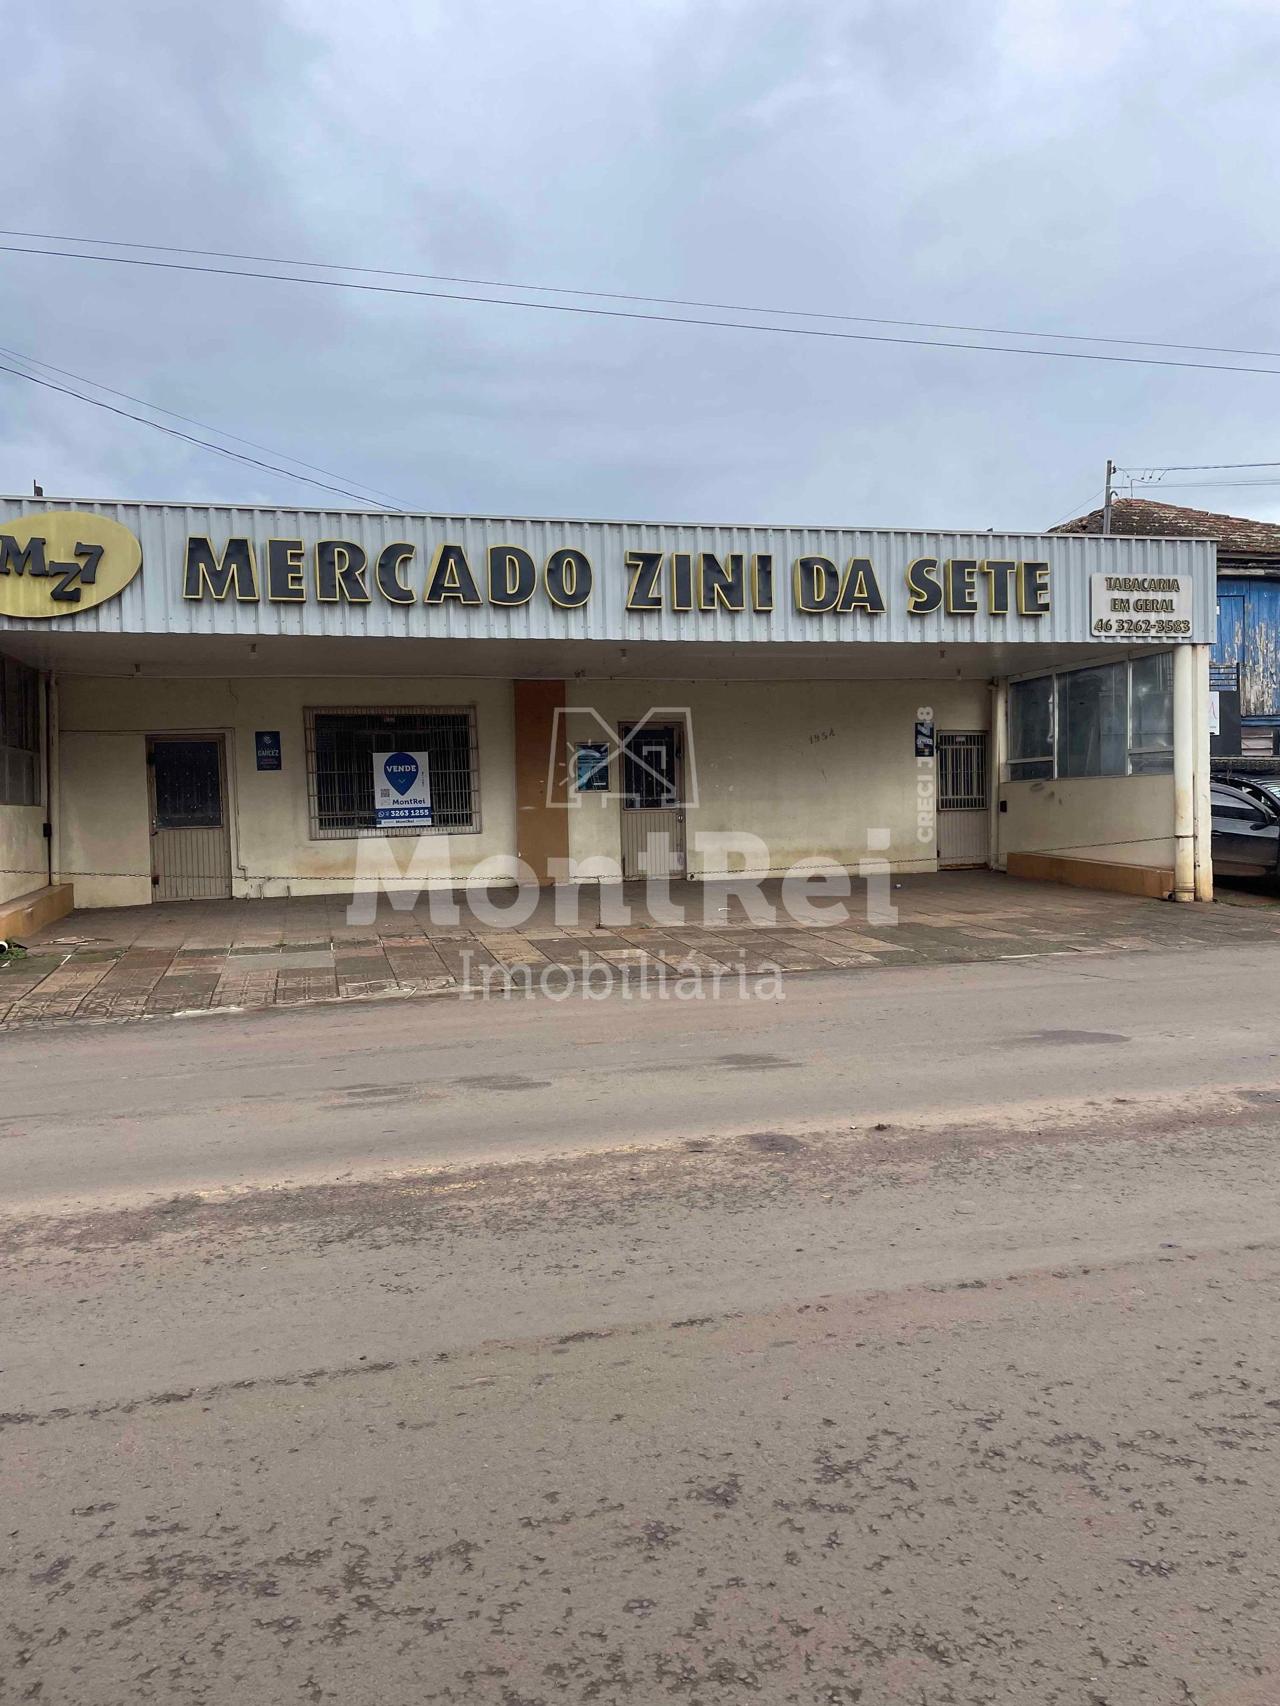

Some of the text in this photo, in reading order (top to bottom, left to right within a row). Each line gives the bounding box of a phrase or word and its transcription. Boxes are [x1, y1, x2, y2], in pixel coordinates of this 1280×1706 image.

[182, 536, 1051, 615] MERCADO ZINI DA SETE
[1105, 577, 1180, 592] TABACARIA
[1110, 598, 1175, 613] EM GERAL
[1094, 618, 1190, 633] 46 3262-3583
[386, 765, 417, 773] VENDE
[392, 798, 426, 806] MontRei
